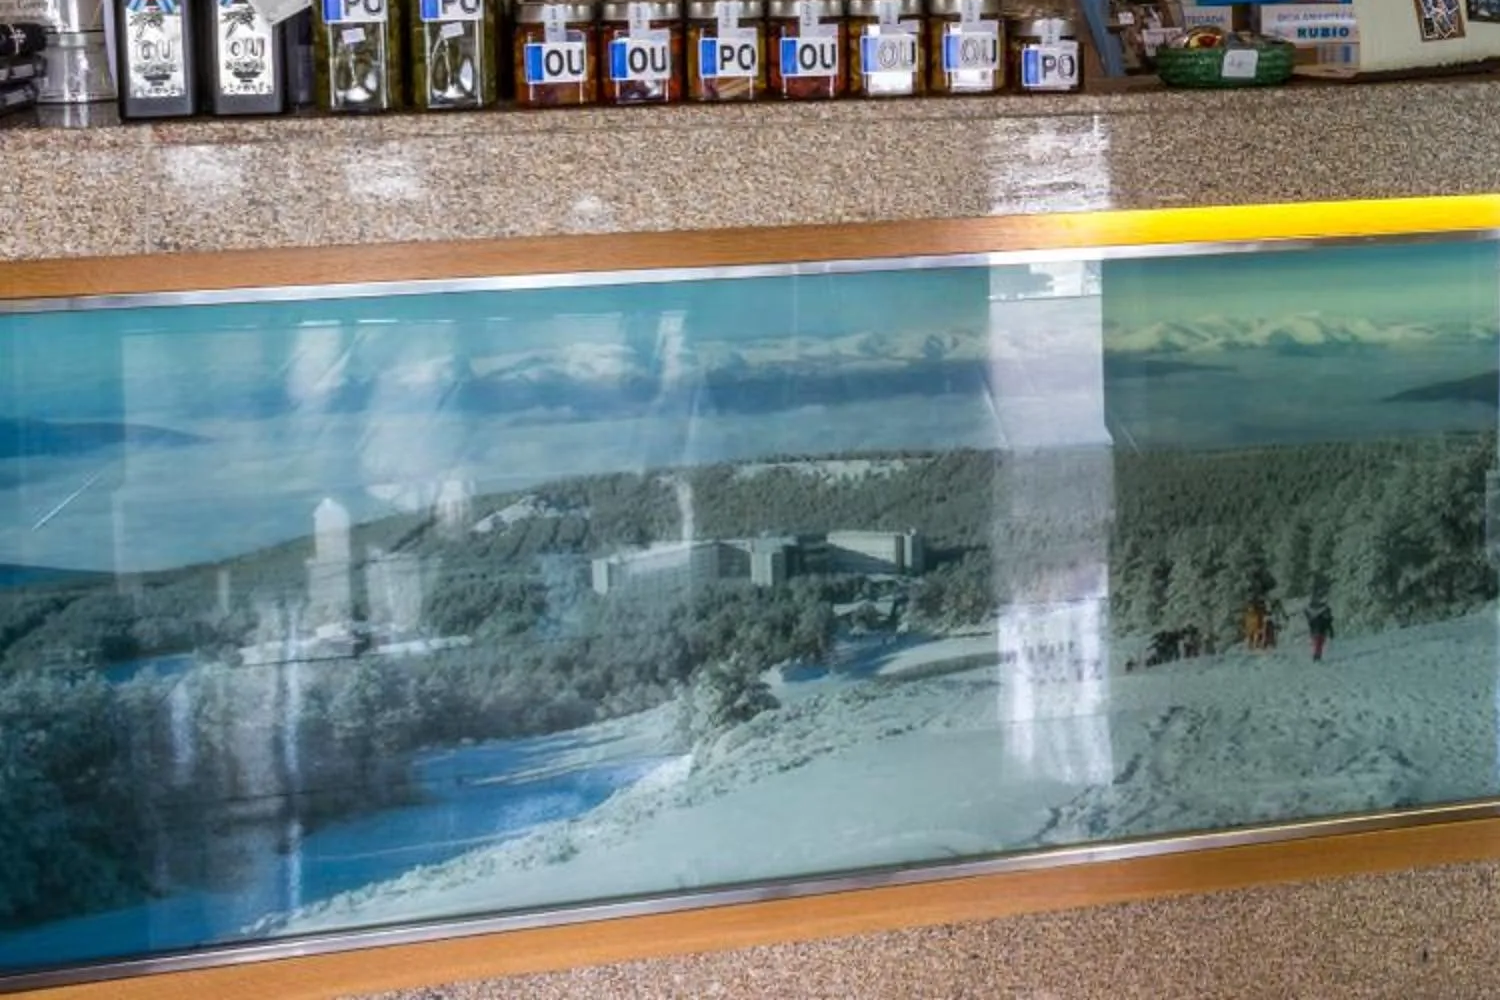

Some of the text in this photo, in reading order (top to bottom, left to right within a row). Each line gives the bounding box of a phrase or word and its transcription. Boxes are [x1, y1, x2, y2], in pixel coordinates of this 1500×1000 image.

[1297, 27, 1349, 38] RUBIO
[545, 49, 585, 77] OU
[628, 46, 667, 73] OU
[719, 43, 756, 71] PO
[799, 43, 837, 70] OU
[878, 41, 916, 68] OU
[961, 39, 997, 64] OU
[1041, 54, 1075, 79] PO
